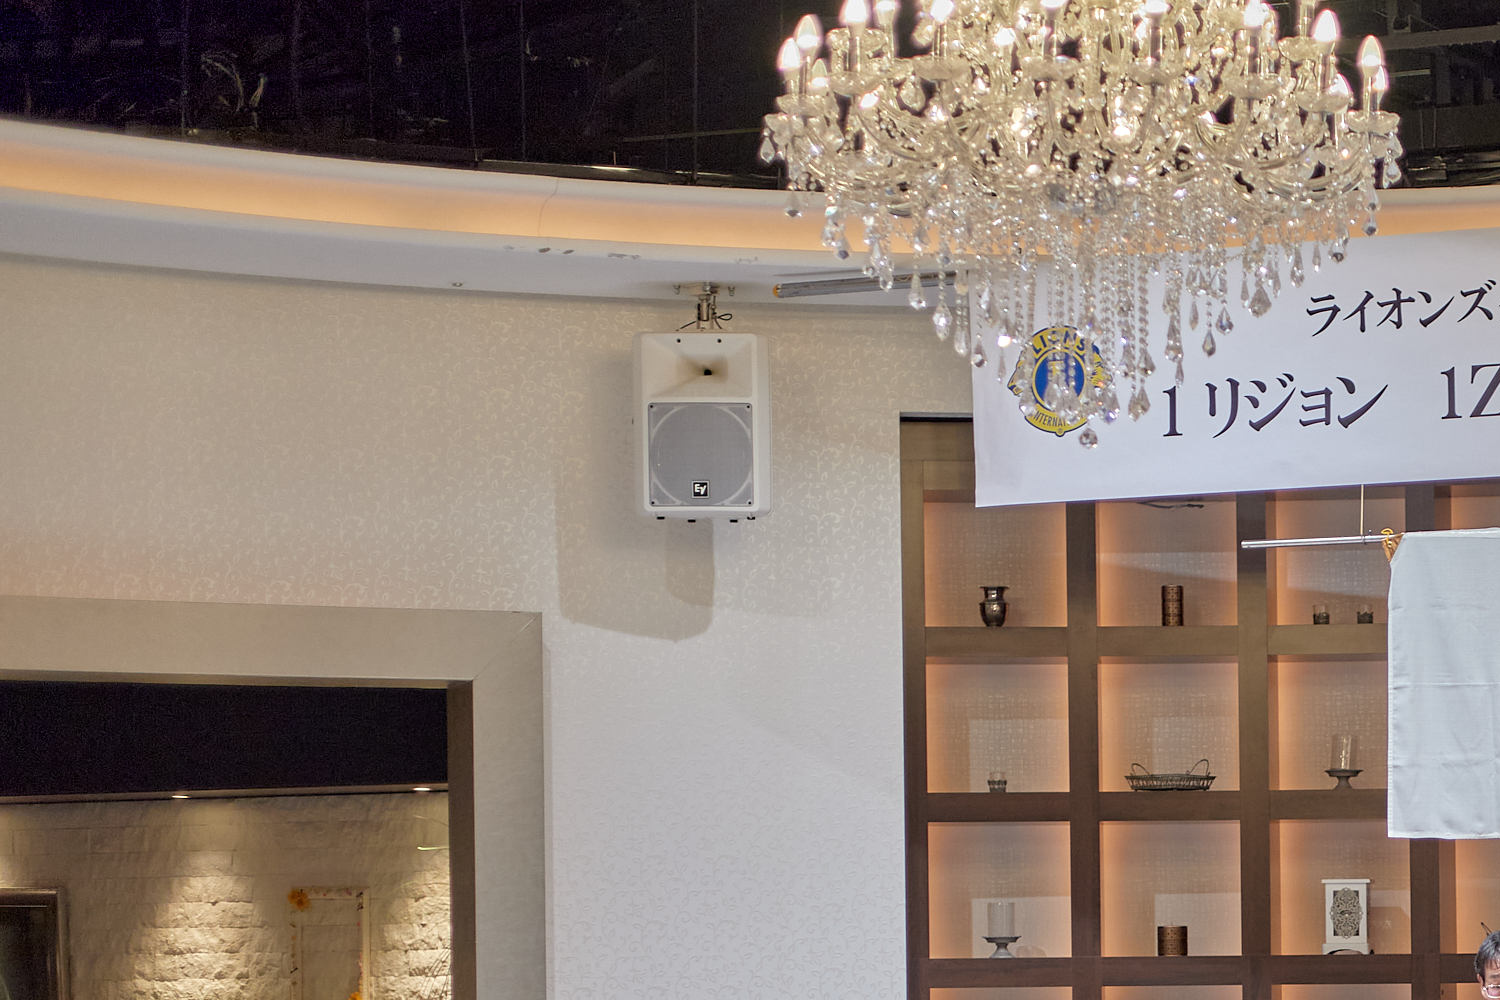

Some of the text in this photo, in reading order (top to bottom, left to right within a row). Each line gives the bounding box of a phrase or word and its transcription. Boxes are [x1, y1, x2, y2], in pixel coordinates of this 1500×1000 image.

[1032, 330, 1085, 355] LIONS
[1204, 372, 1388, 439] リジョン
